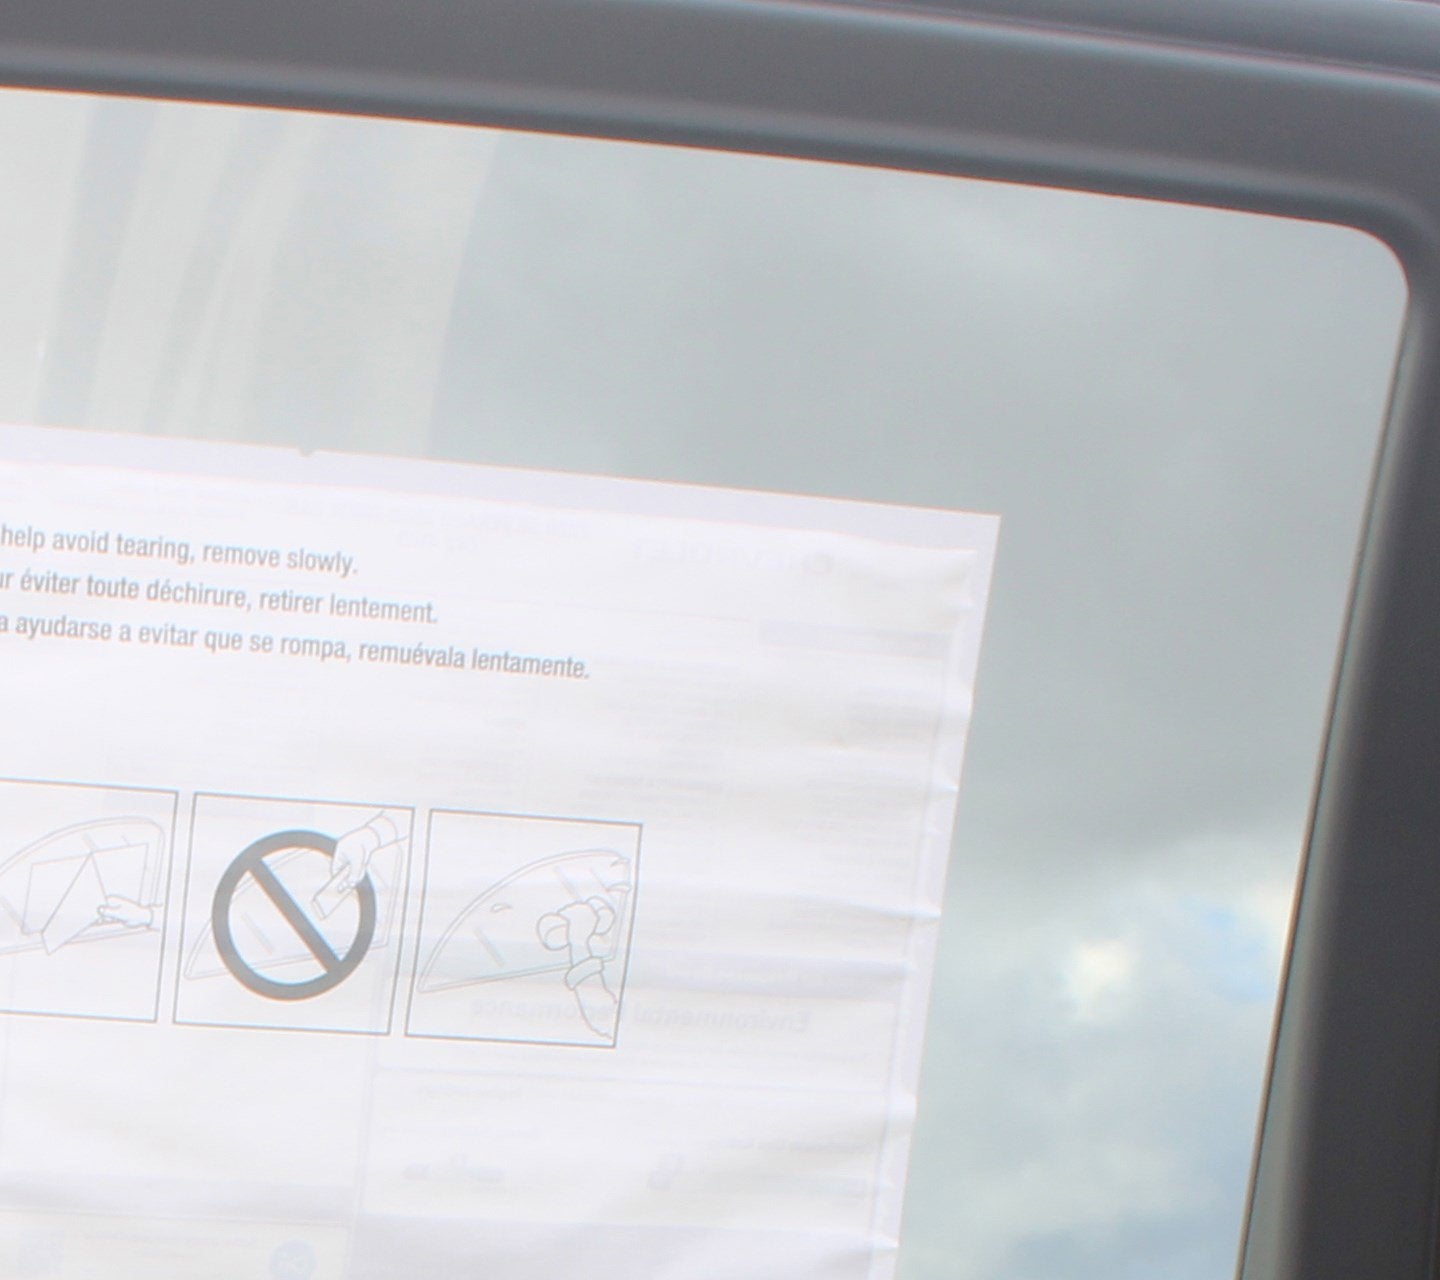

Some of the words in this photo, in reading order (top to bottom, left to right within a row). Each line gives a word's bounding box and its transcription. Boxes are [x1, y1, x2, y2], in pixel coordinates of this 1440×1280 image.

[1, 524, 45, 552] help
[53, 531, 109, 553] avoid
[117, 534, 194, 564] tearing,
[203, 545, 280, 567] remove
[287, 549, 357, 578] slowly.
[21, 569, 79, 594] éviter
[87, 575, 139, 599] toute
[147, 580, 251, 611] déchirure,
[260, 591, 322, 612] retirer
[330, 594, 437, 623] lentement.
[15, 615, 112, 640] ayudarse
[119, 625, 131, 641] a
[139, 625, 198, 646] evitar
[205, 631, 242, 653] que
[250, 635, 273, 652] se
[281, 638, 351, 662] rompa,
[359, 642, 465, 668] remuévala
[472, 648, 589, 679] lentamente.
